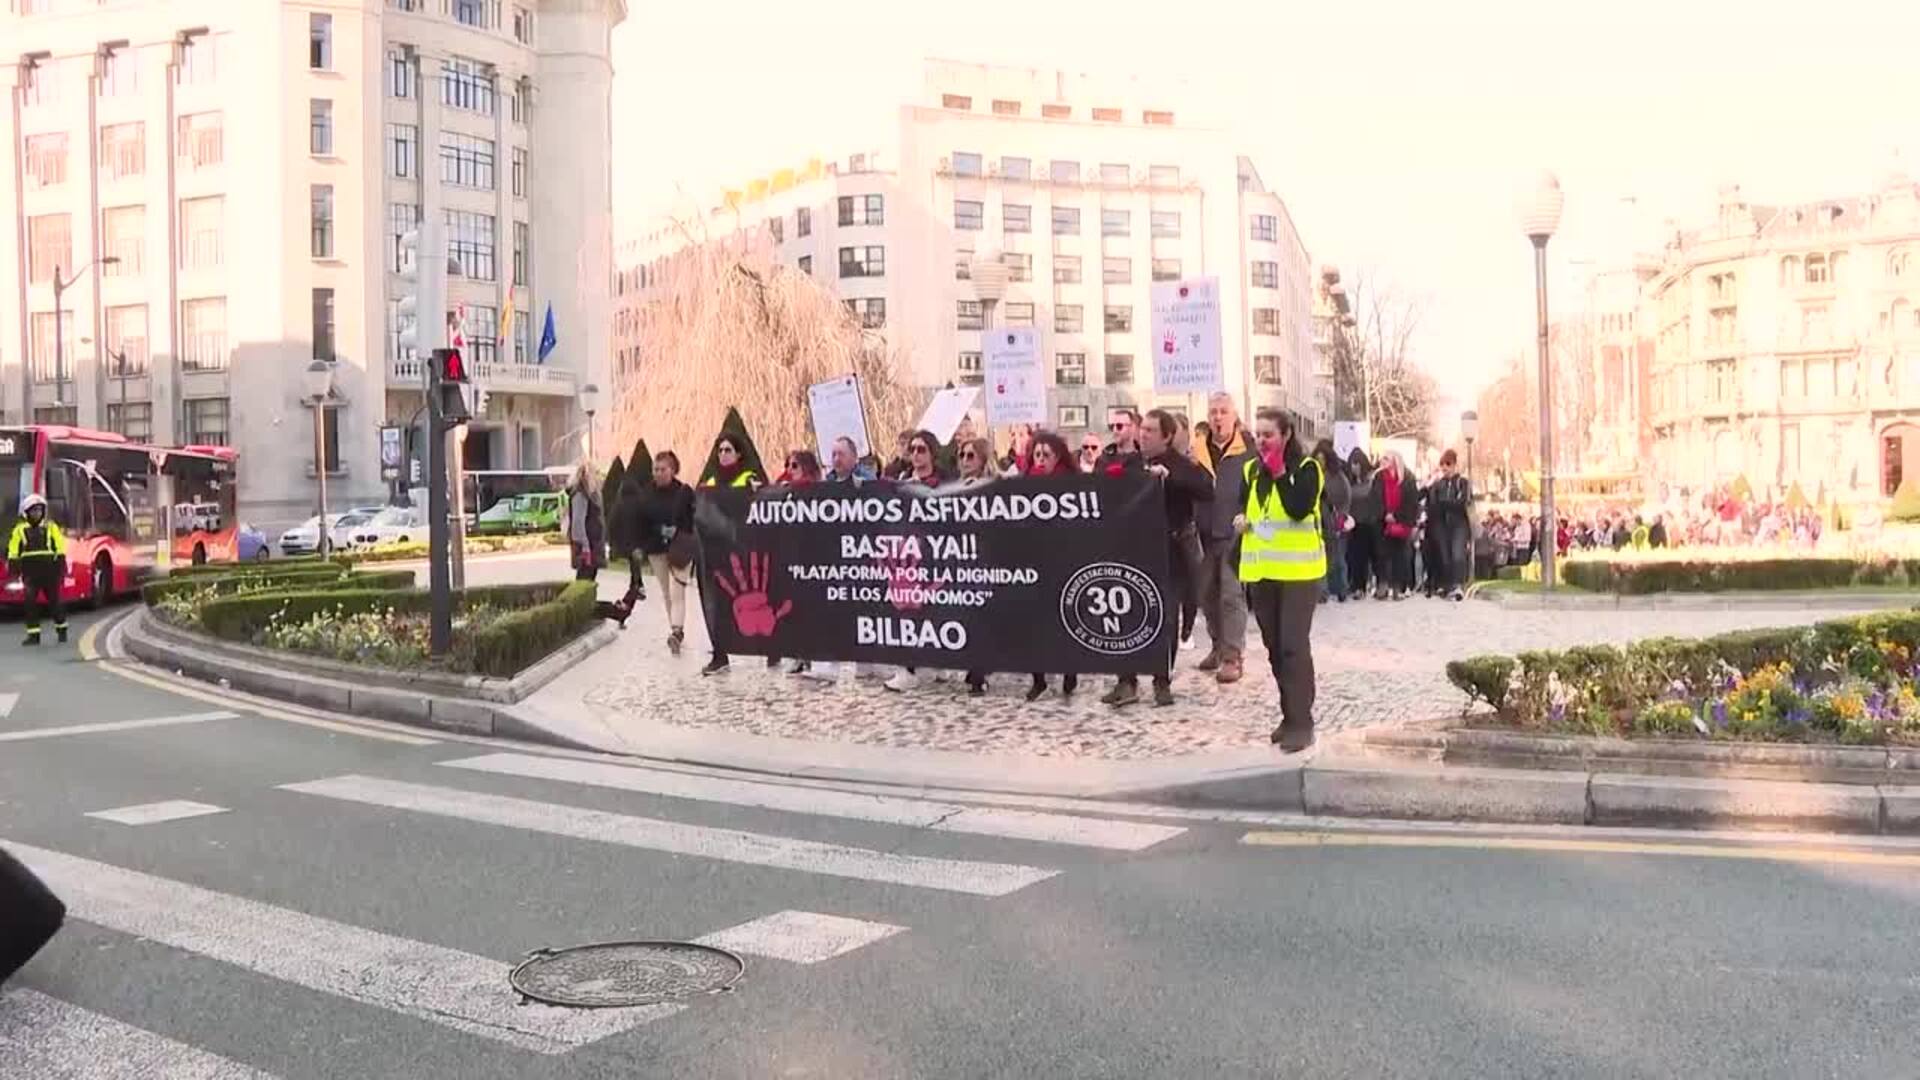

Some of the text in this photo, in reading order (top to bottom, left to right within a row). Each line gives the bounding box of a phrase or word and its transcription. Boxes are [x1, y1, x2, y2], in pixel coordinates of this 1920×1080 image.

[746, 491, 1101, 525] AUTÓNOMOS ASFIXIADOS!!
[840, 533, 978, 560] BASTA YA!!
[787, 564, 1039, 585] "PLATAFORMA POR LA DIGNIDAD
[827, 584, 994, 607] DE LOS AUTÓNOMOS"
[1085, 585, 1132, 616] 30
[856, 615, 968, 651] BILBAO
[1102, 615, 1121, 634] N
